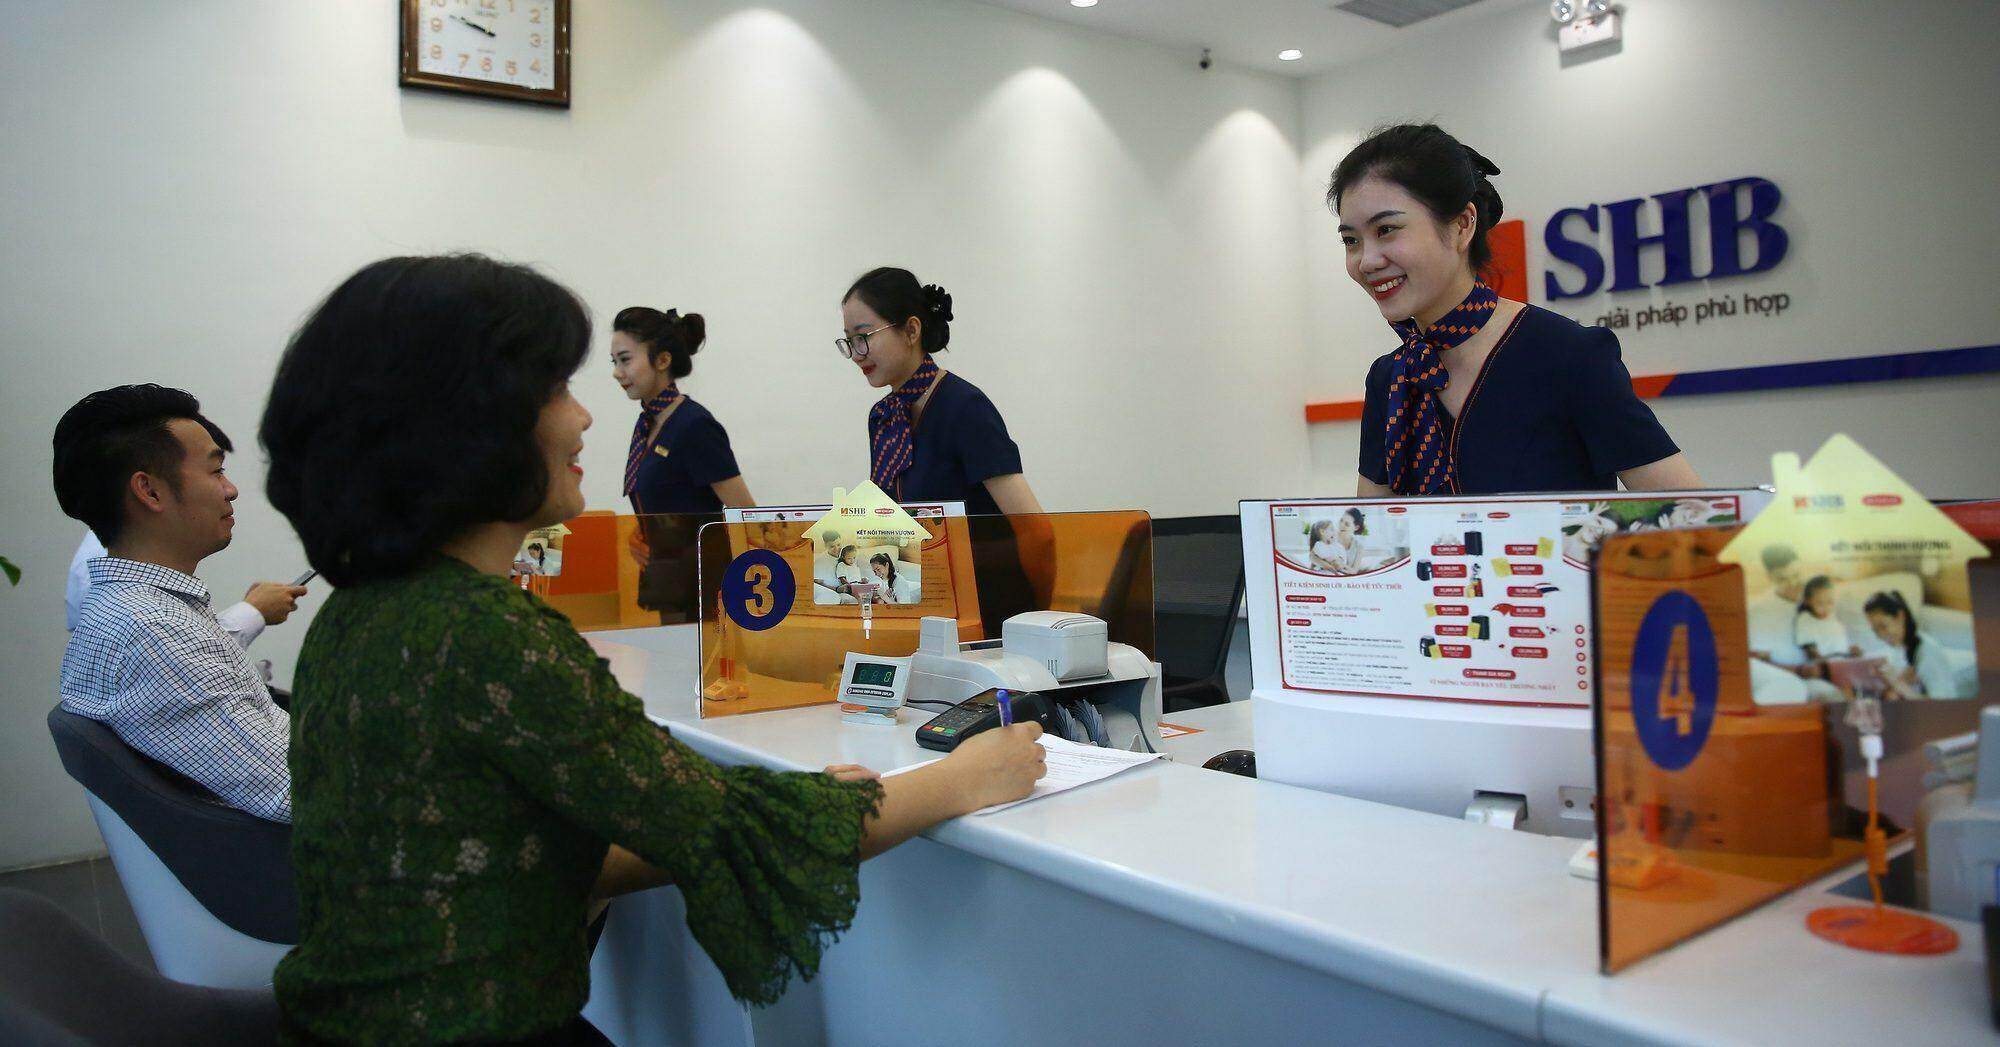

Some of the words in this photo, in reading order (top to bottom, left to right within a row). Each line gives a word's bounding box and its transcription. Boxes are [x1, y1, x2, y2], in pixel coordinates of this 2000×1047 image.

[529, 8, 541, 24] 2
[458, 53, 470, 70] 7
[1544, 176, 1789, 302] SHB
[1636, 301, 1688, 331] pháp
[1695, 294, 1737, 325] phù
[1744, 292, 1790, 317] hợp
[848, 507, 866, 515] SHB
[744, 563, 775, 618] 3
[1657, 623, 1696, 737] 4
